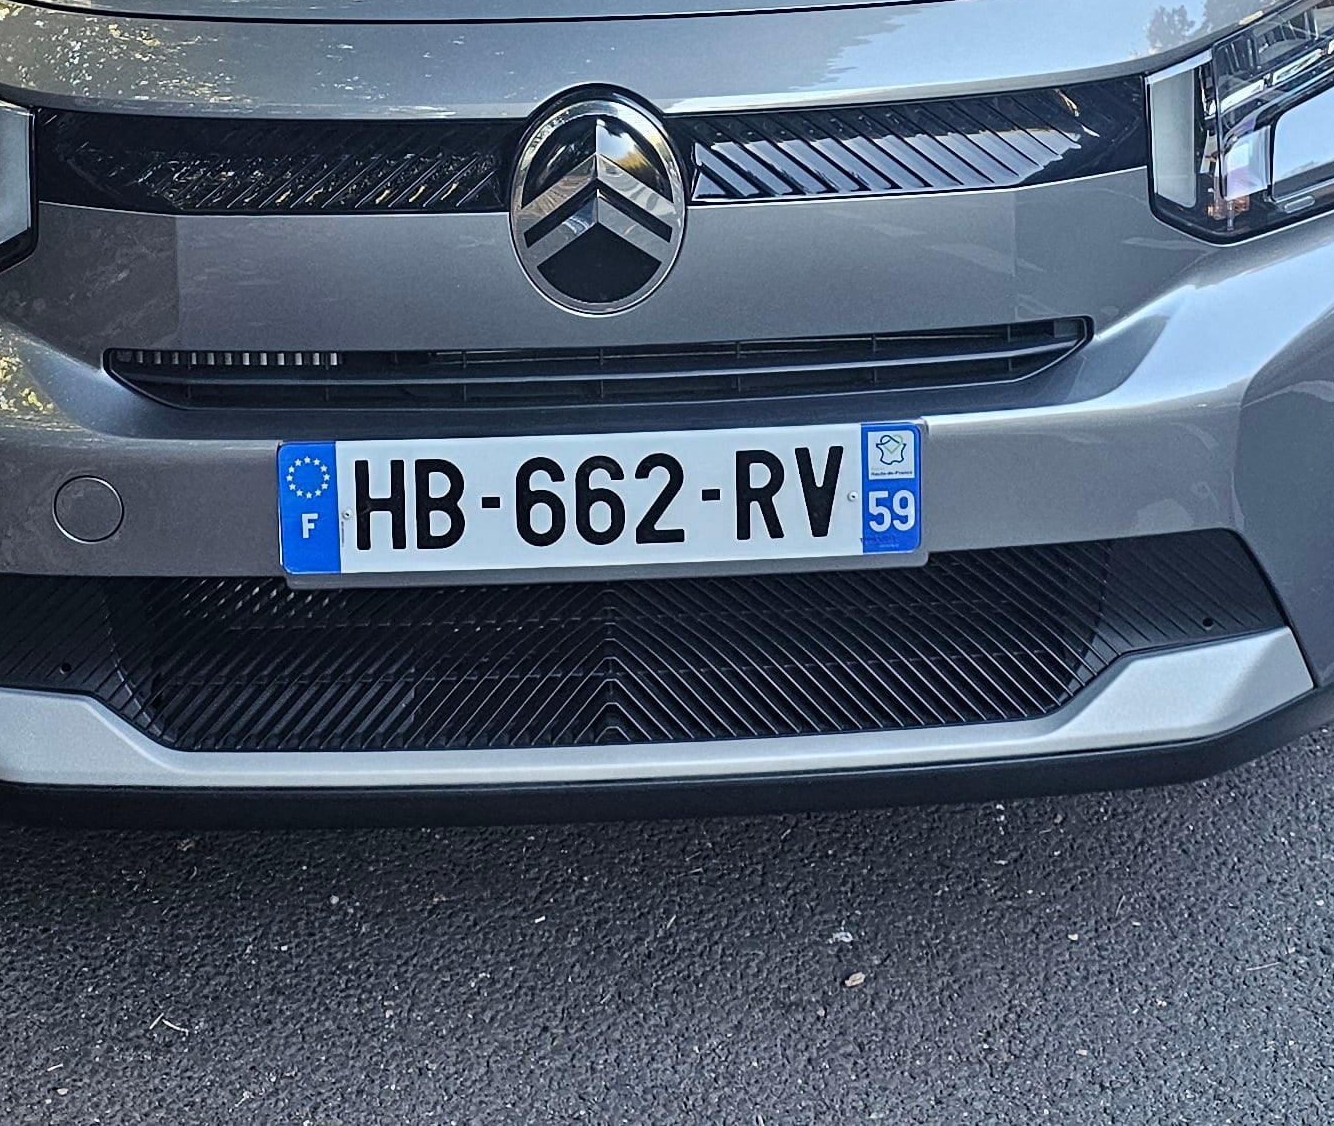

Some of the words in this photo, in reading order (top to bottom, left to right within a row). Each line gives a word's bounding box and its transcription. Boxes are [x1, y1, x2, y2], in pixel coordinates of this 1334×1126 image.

[353, 445, 844, 551] HB-662-RV
[868, 489, 915, 532] 59
[301, 512, 319, 539] F
